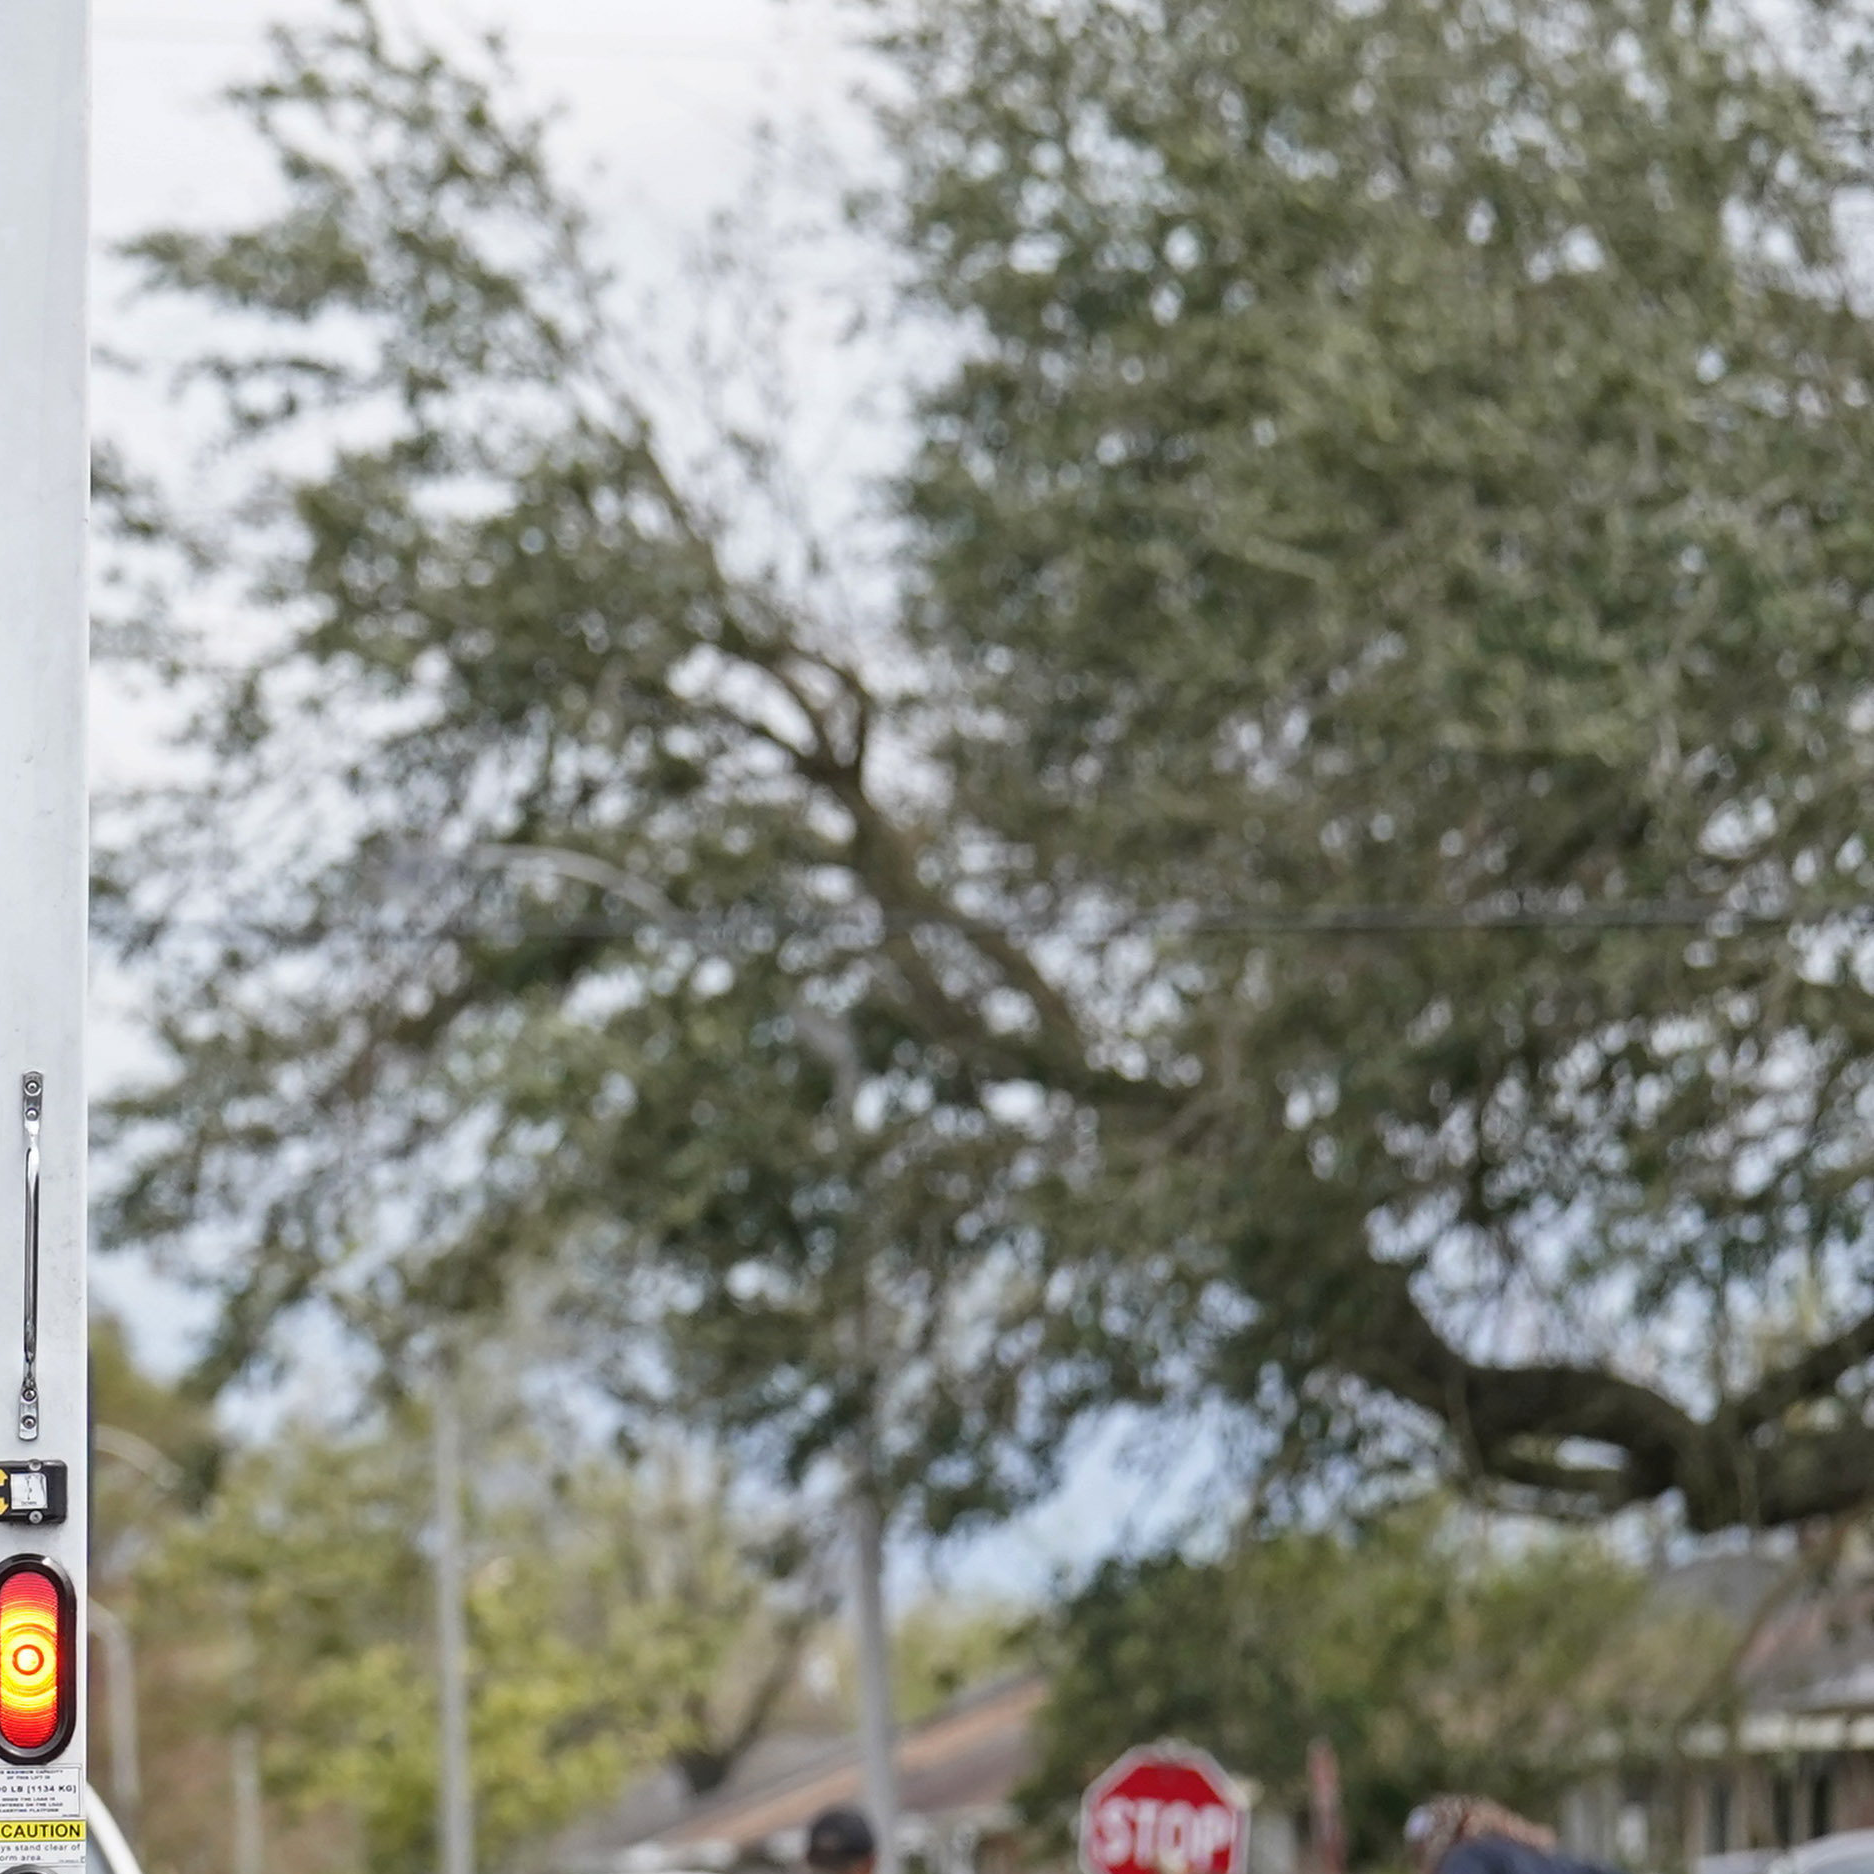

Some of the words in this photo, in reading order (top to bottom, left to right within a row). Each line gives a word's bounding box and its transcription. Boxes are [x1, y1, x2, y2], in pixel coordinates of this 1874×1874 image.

[27, 1785, 55, 1794] [1134
[59, 1785, 76, 1793] KG]
[1, 1824, 80, 1838] CAUTION
[1093, 1796, 1231, 1874] STOP
